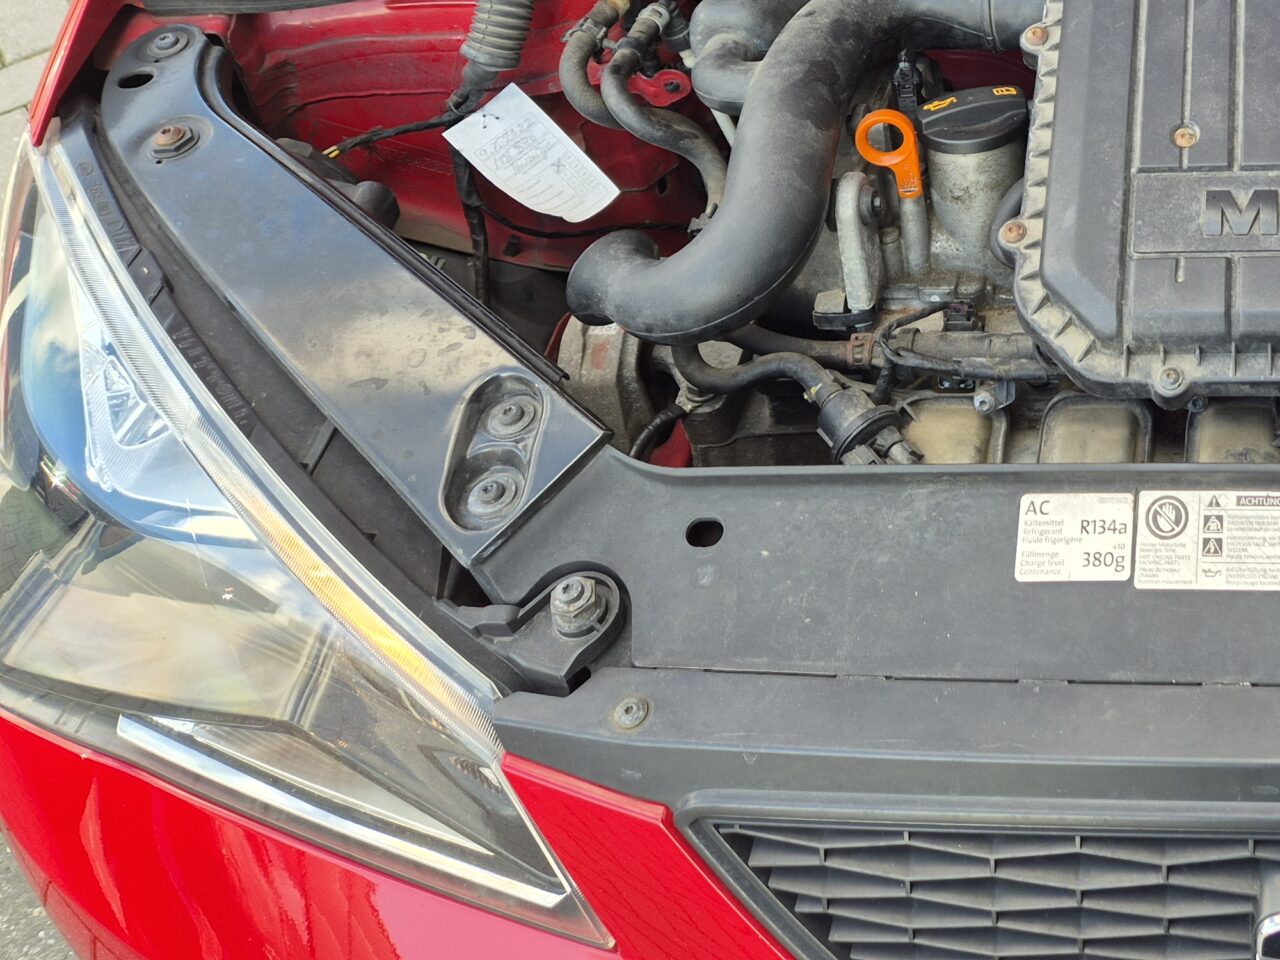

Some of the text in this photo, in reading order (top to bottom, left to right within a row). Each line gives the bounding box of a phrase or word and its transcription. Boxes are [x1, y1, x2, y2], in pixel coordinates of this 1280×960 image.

[1025, 500, 1050, 515] AC
[1024, 519, 1127, 535] Kältemittel R134a
[1023, 528, 1063, 537] Refrigerant
[1045, 536, 1082, 545] frigorigène
[1020, 559, 1065, 568] Charge level
[1021, 551, 1126, 572] Füllmenge 380g
[1019, 567, 1062, 576] Contenance
